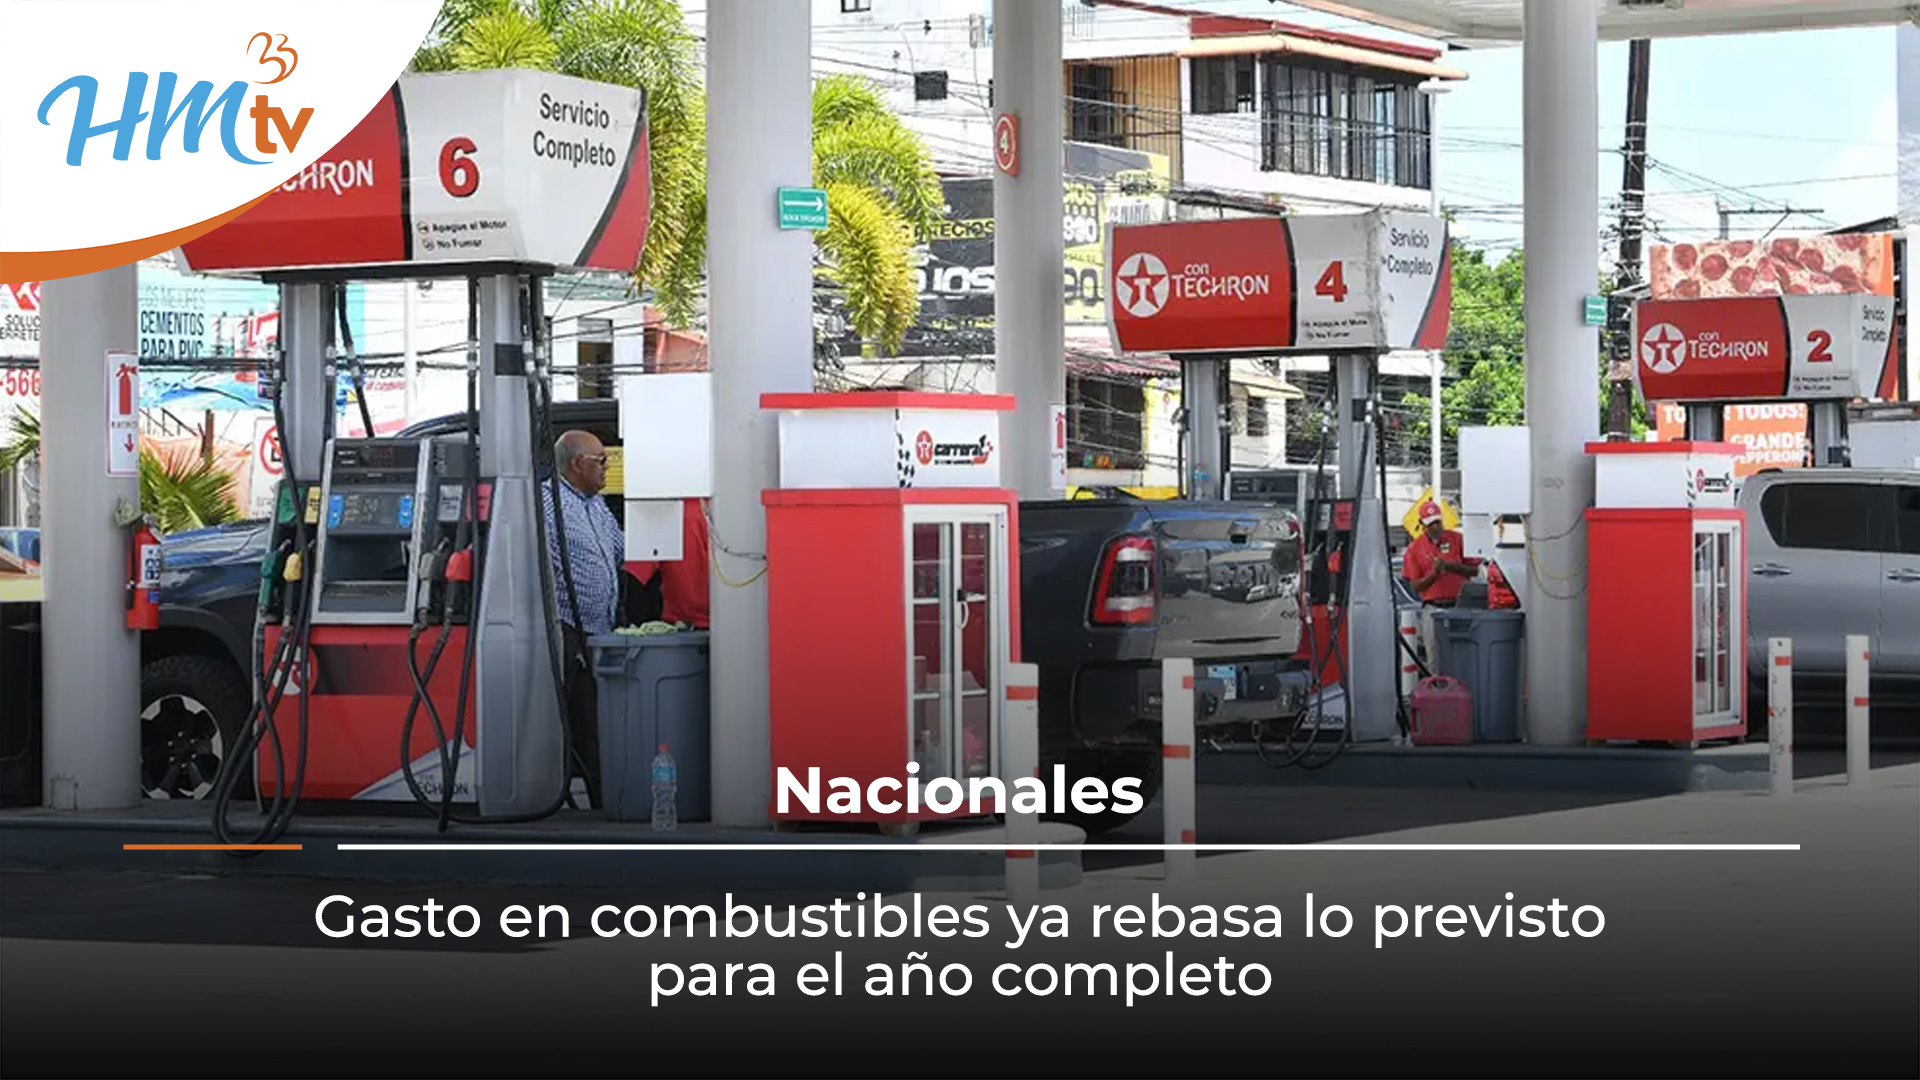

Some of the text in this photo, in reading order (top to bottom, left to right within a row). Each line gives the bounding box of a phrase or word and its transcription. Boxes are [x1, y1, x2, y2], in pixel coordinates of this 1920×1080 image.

[539, 93, 610, 129] Servicio
[532, 130, 616, 168] Completo
[1000, 129, 1009, 155] 4
[438, 136, 481, 199] 6
[436, 240, 451, 250] No
[1390, 226, 1430, 248] Servicio
[1184, 262, 1210, 276] con
[1387, 254, 1433, 278] Completo
[1171, 273, 1270, 301] TECHRON
[1315, 260, 1349, 303] 4
[140, 310, 205, 336] CEMENTOS
[1688, 339, 1769, 361] TECHRON
[1699, 332, 1719, 342] con
[1806, 329, 1834, 363] 2
